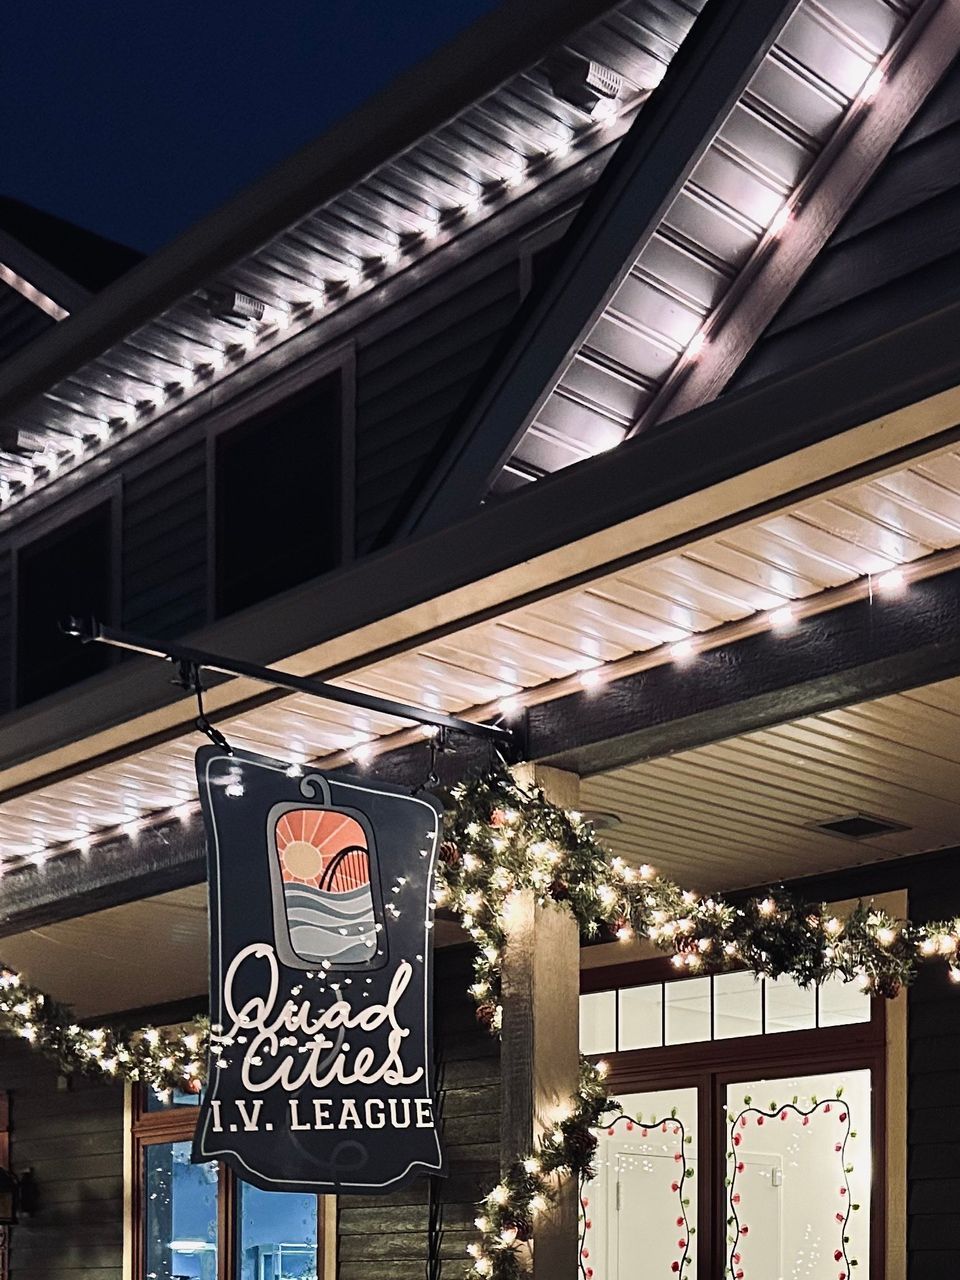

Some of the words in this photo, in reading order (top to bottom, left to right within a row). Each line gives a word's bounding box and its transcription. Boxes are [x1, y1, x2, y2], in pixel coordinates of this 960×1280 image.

[211, 943, 410, 1042] Quad
[241, 1028, 424, 1092] Cities
[211, 1100, 274, 1132] I.V.
[288, 1098, 434, 1131] LEAGUE
